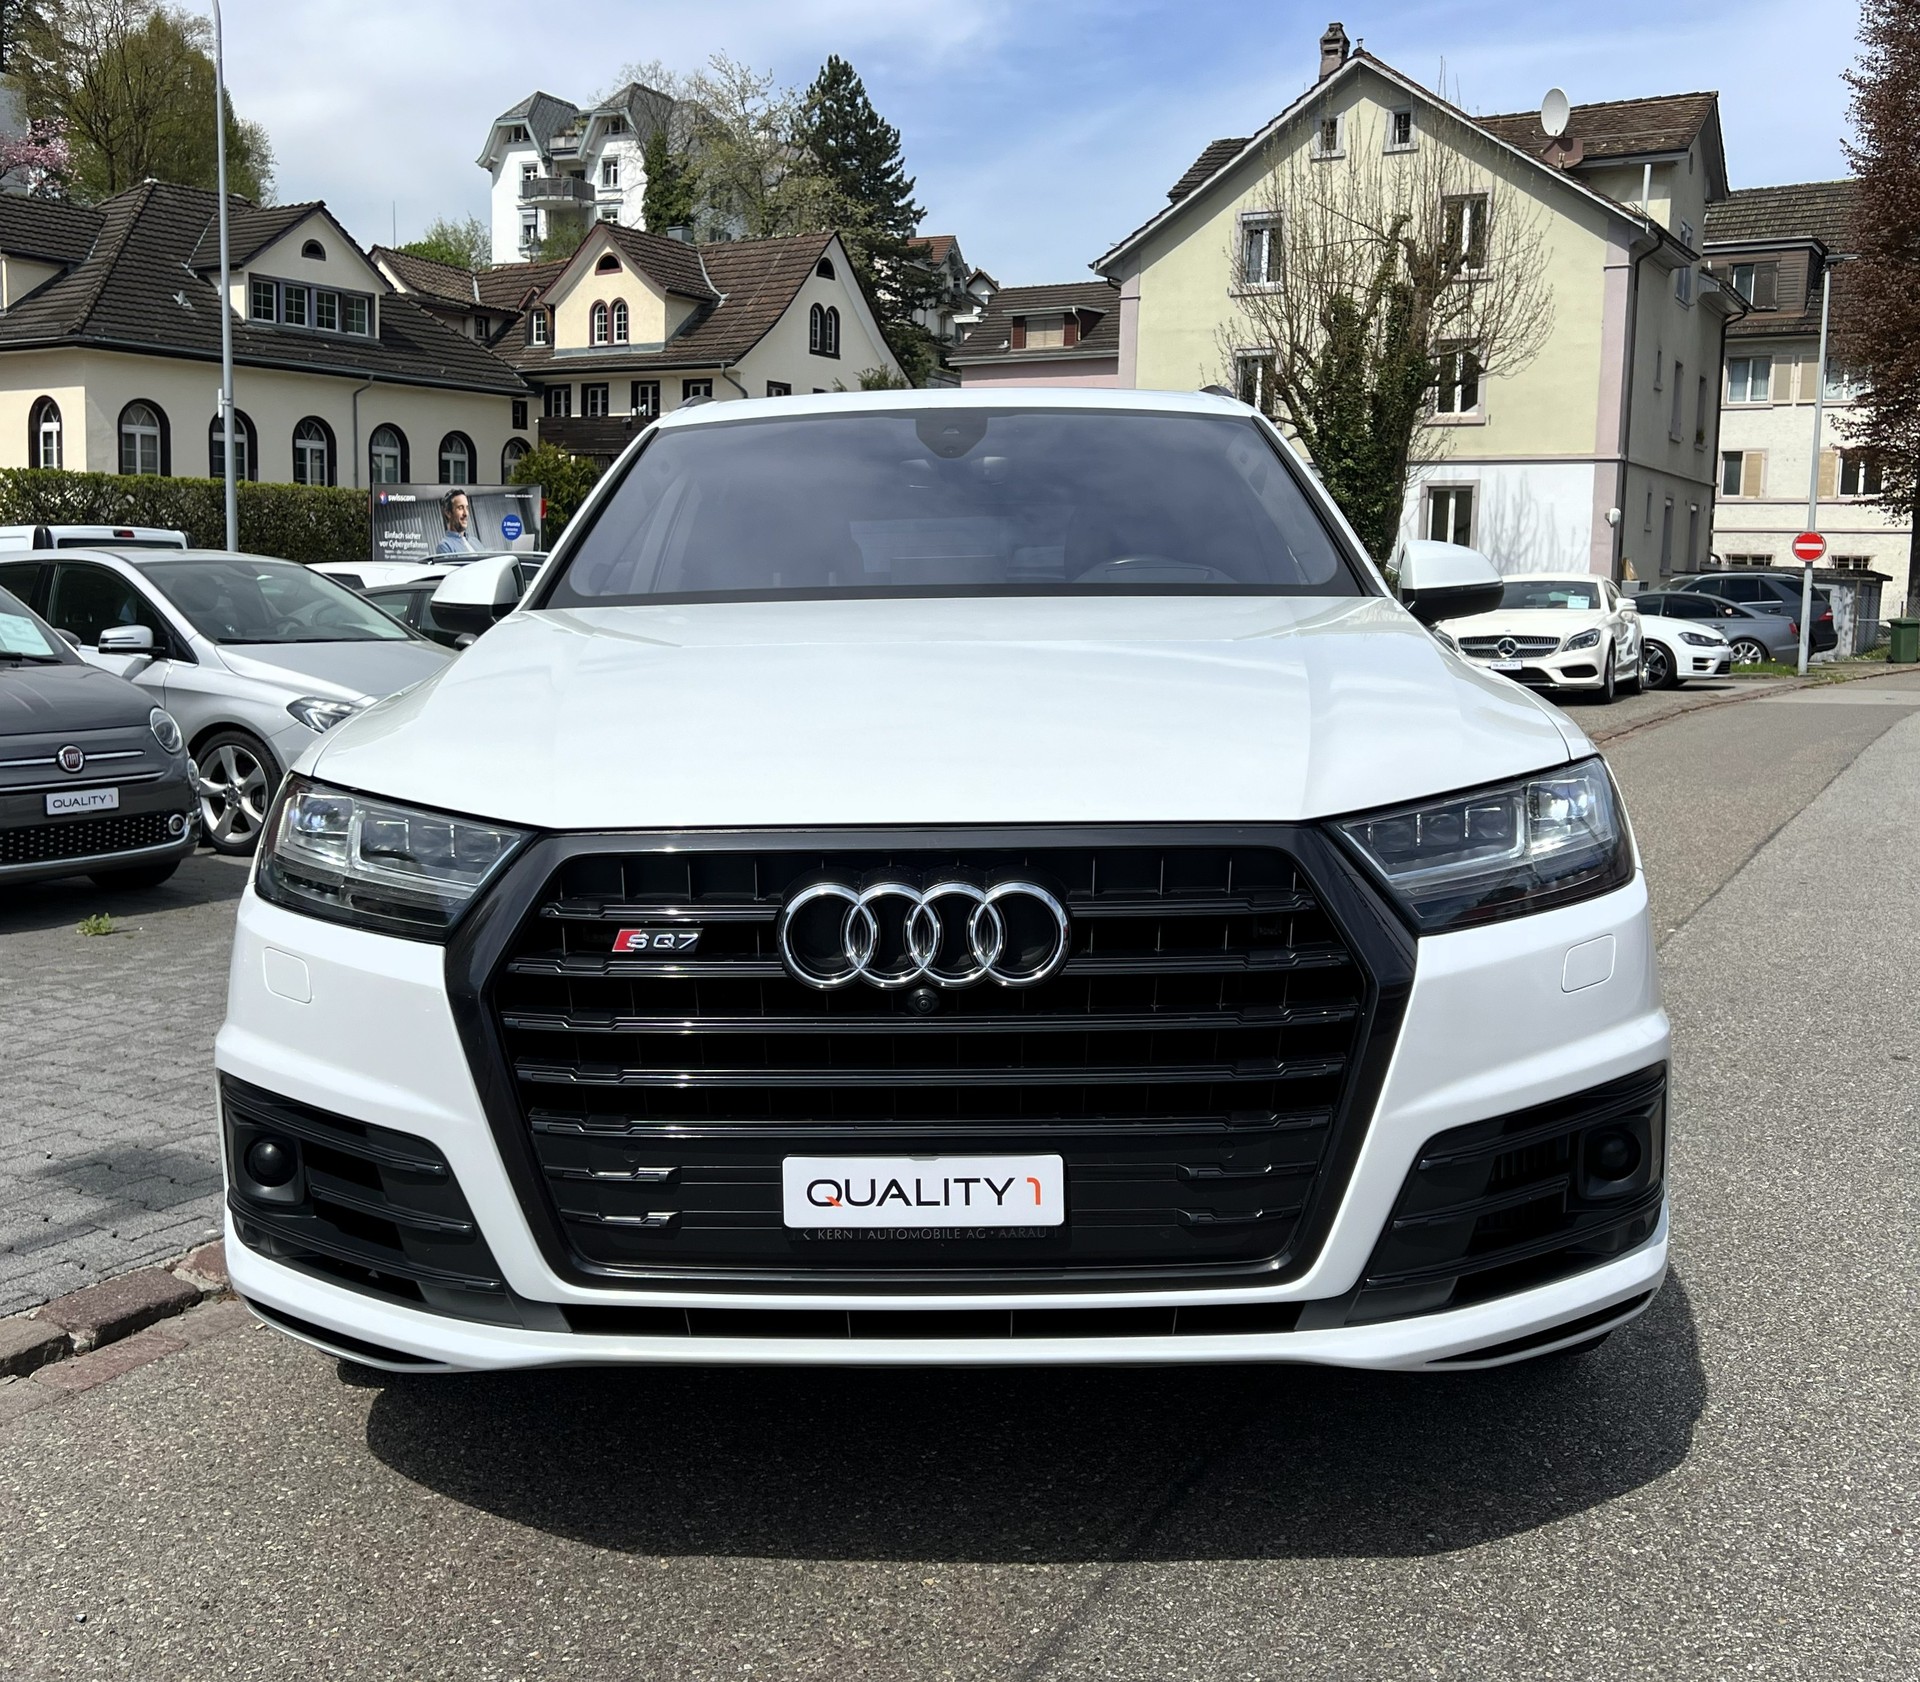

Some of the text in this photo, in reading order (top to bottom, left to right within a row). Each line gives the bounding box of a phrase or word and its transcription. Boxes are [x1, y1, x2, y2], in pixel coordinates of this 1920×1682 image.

[388, 493, 416, 502] swisscom
[384, 531, 421, 540] Einfach sicher
[389, 540, 428, 550] Cybergefahren
[65, 753, 79, 766] FIAT
[52, 794, 107, 809] QUALITY
[626, 933, 699, 949] SQ7
[806, 1177, 1041, 1207] QUALITY 1
[817, 1227, 1047, 1240] KERN AUTOMOBILE AG AARAU
